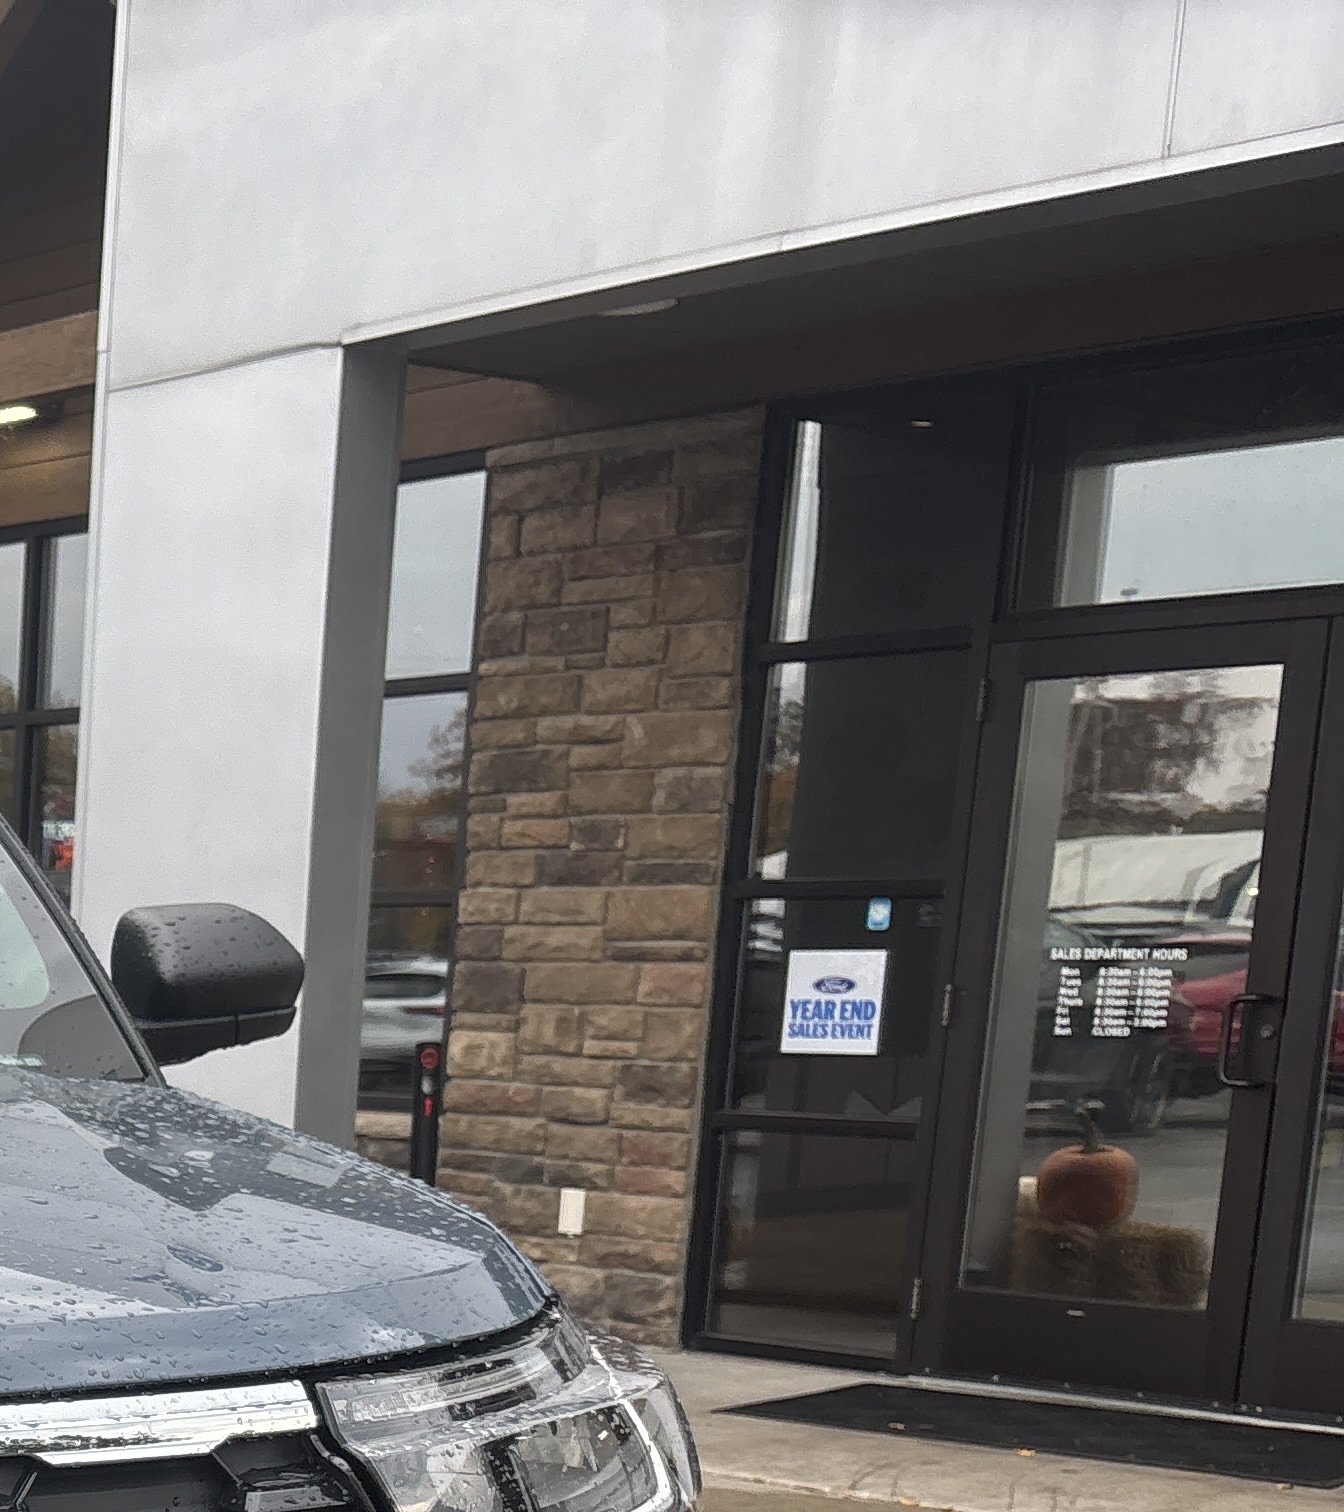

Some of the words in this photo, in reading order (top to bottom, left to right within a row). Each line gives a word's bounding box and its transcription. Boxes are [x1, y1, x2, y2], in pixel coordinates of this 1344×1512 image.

[1050, 948, 1082, 960] SALES
[1084, 948, 1150, 960] DEPARTMENT
[1152, 948, 1188, 960] HOURS
[789, 999, 836, 1021] YEAR
[839, 999, 876, 1021] END
[788, 1023, 829, 1039] SALES
[831, 1023, 873, 1040] EVENT
[1092, 1026, 1130, 1037] CLOSED
